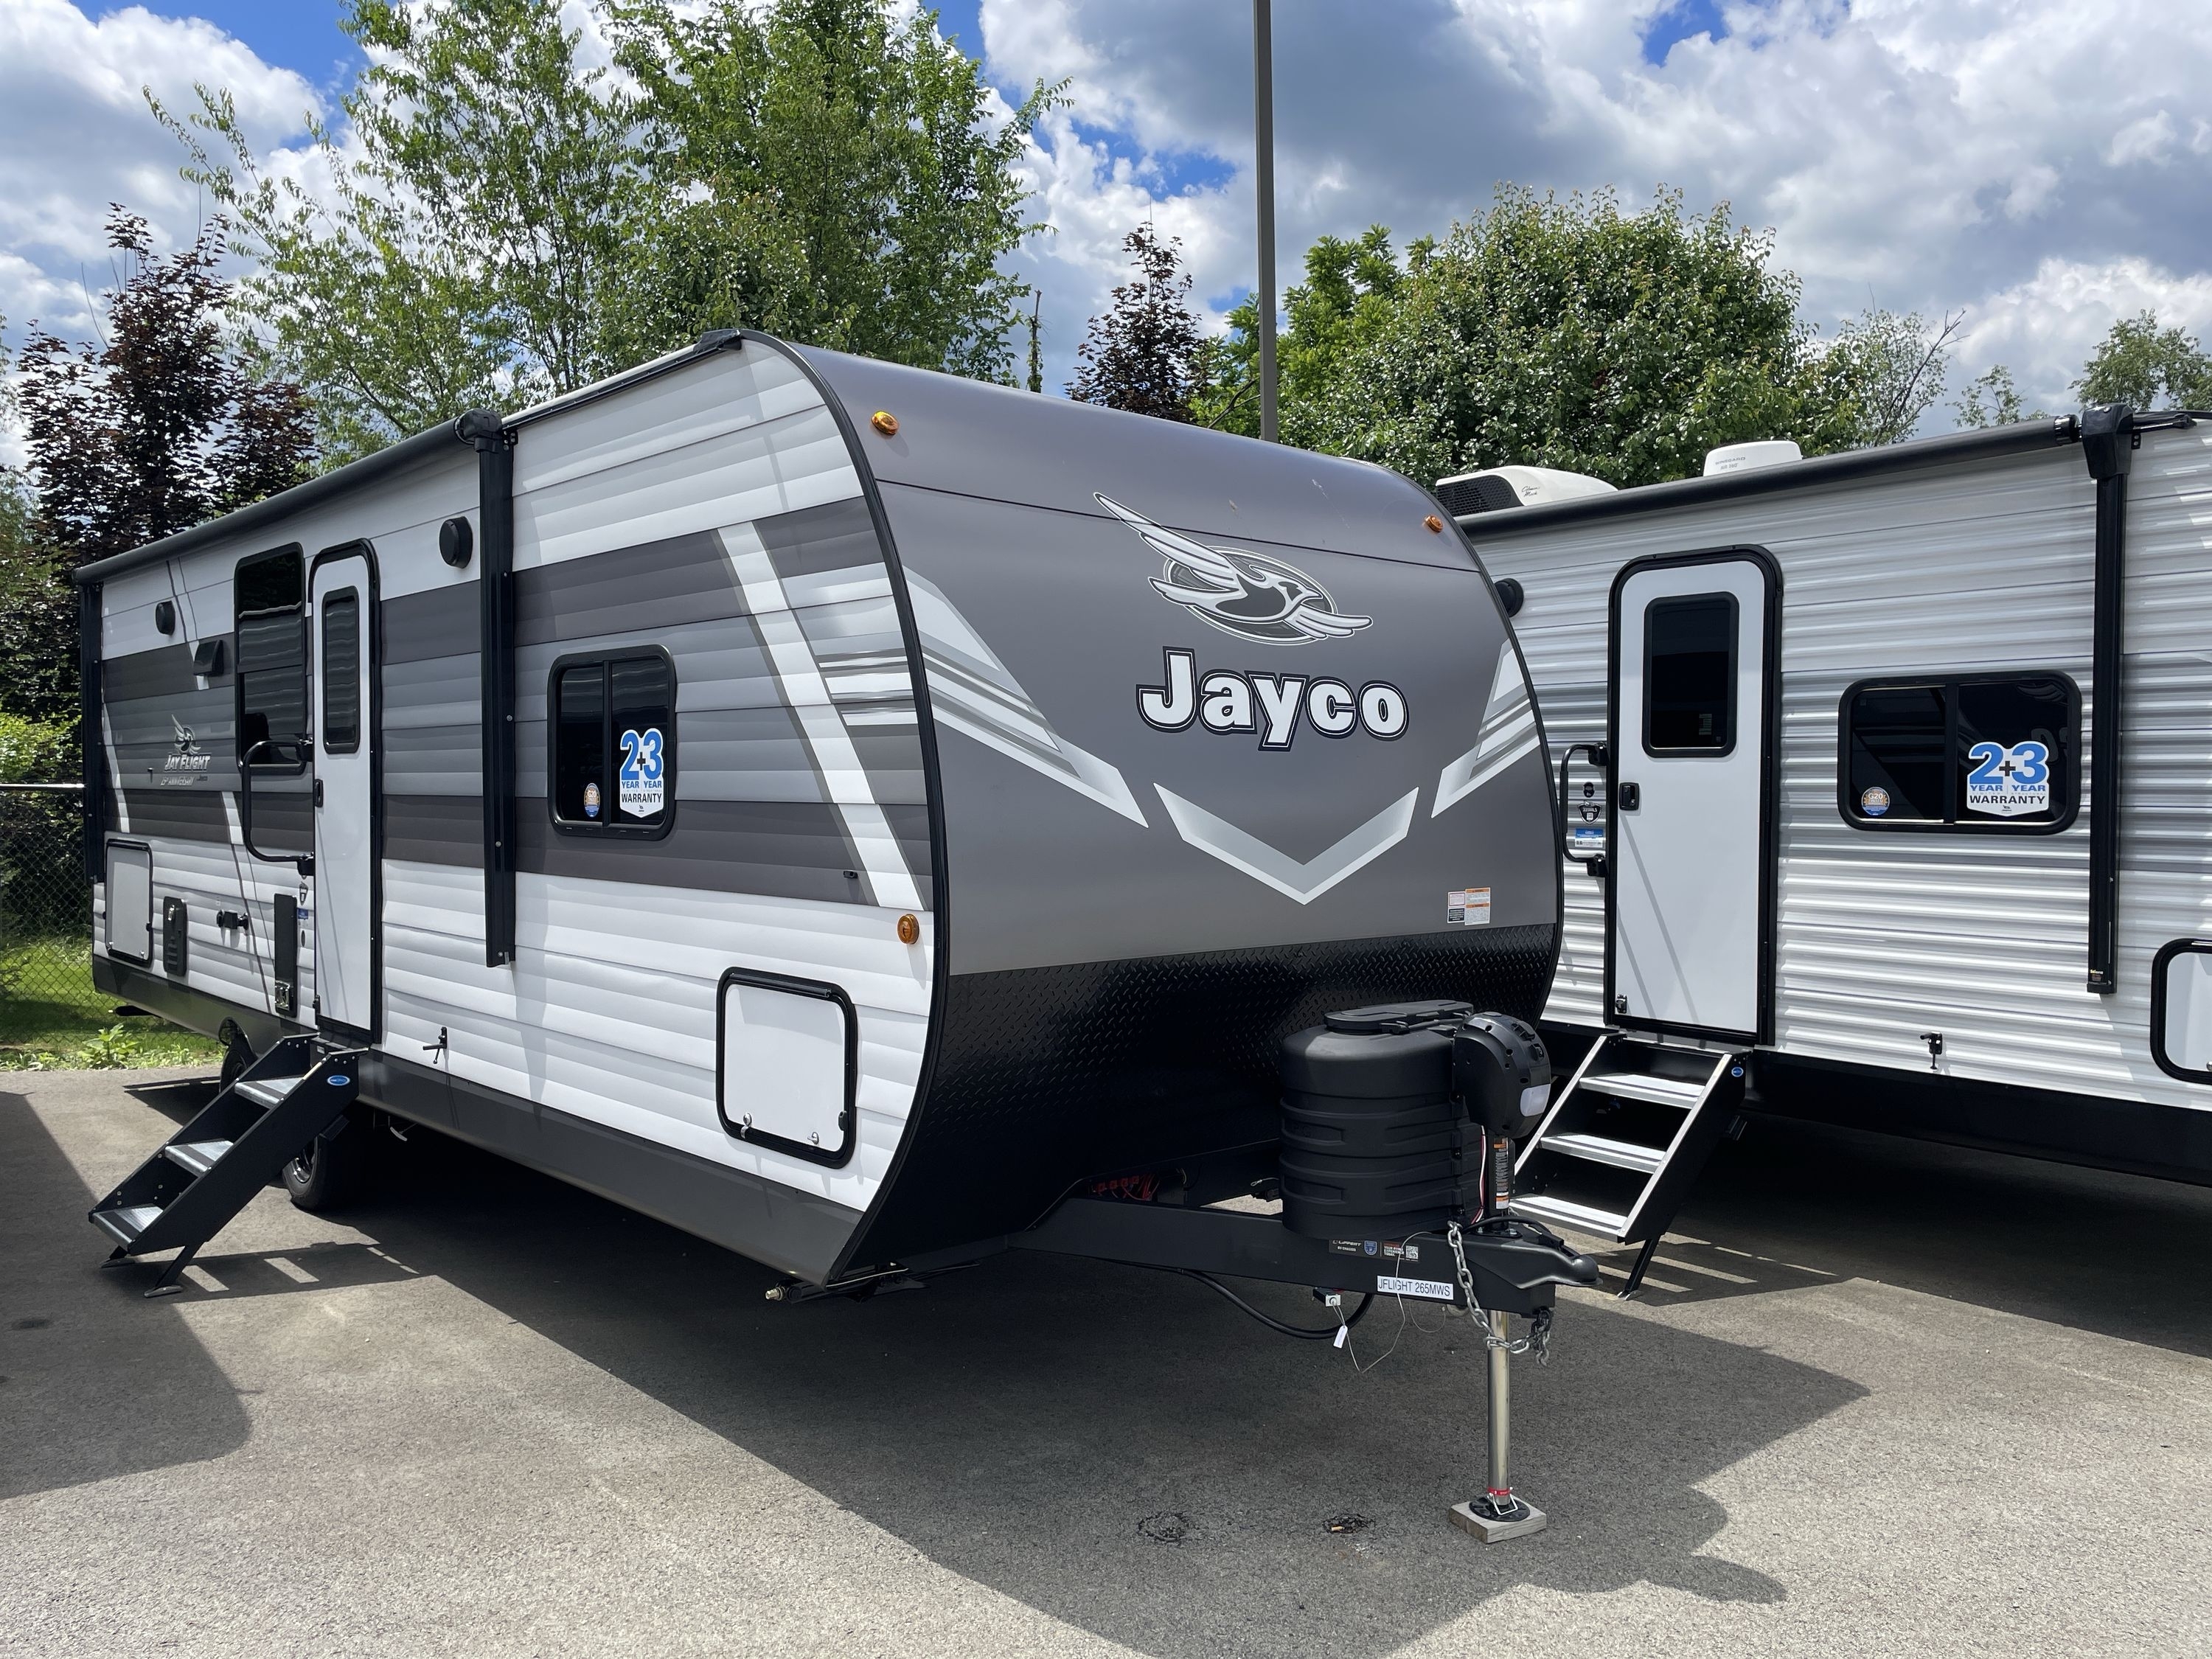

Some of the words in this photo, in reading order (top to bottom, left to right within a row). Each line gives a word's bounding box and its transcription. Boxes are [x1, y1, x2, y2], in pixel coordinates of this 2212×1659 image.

[1136, 646, 1409, 751] Jayco
[164, 754, 181, 770] JAY
[179, 754, 211, 771] FLIGHT
[622, 793, 662, 803] WARRANTY
[1969, 796, 2045, 804] WARRANTY
[1379, 1279, 1413, 1291] JFLIGHT
[1415, 1282, 1450, 1296] 265MWS
